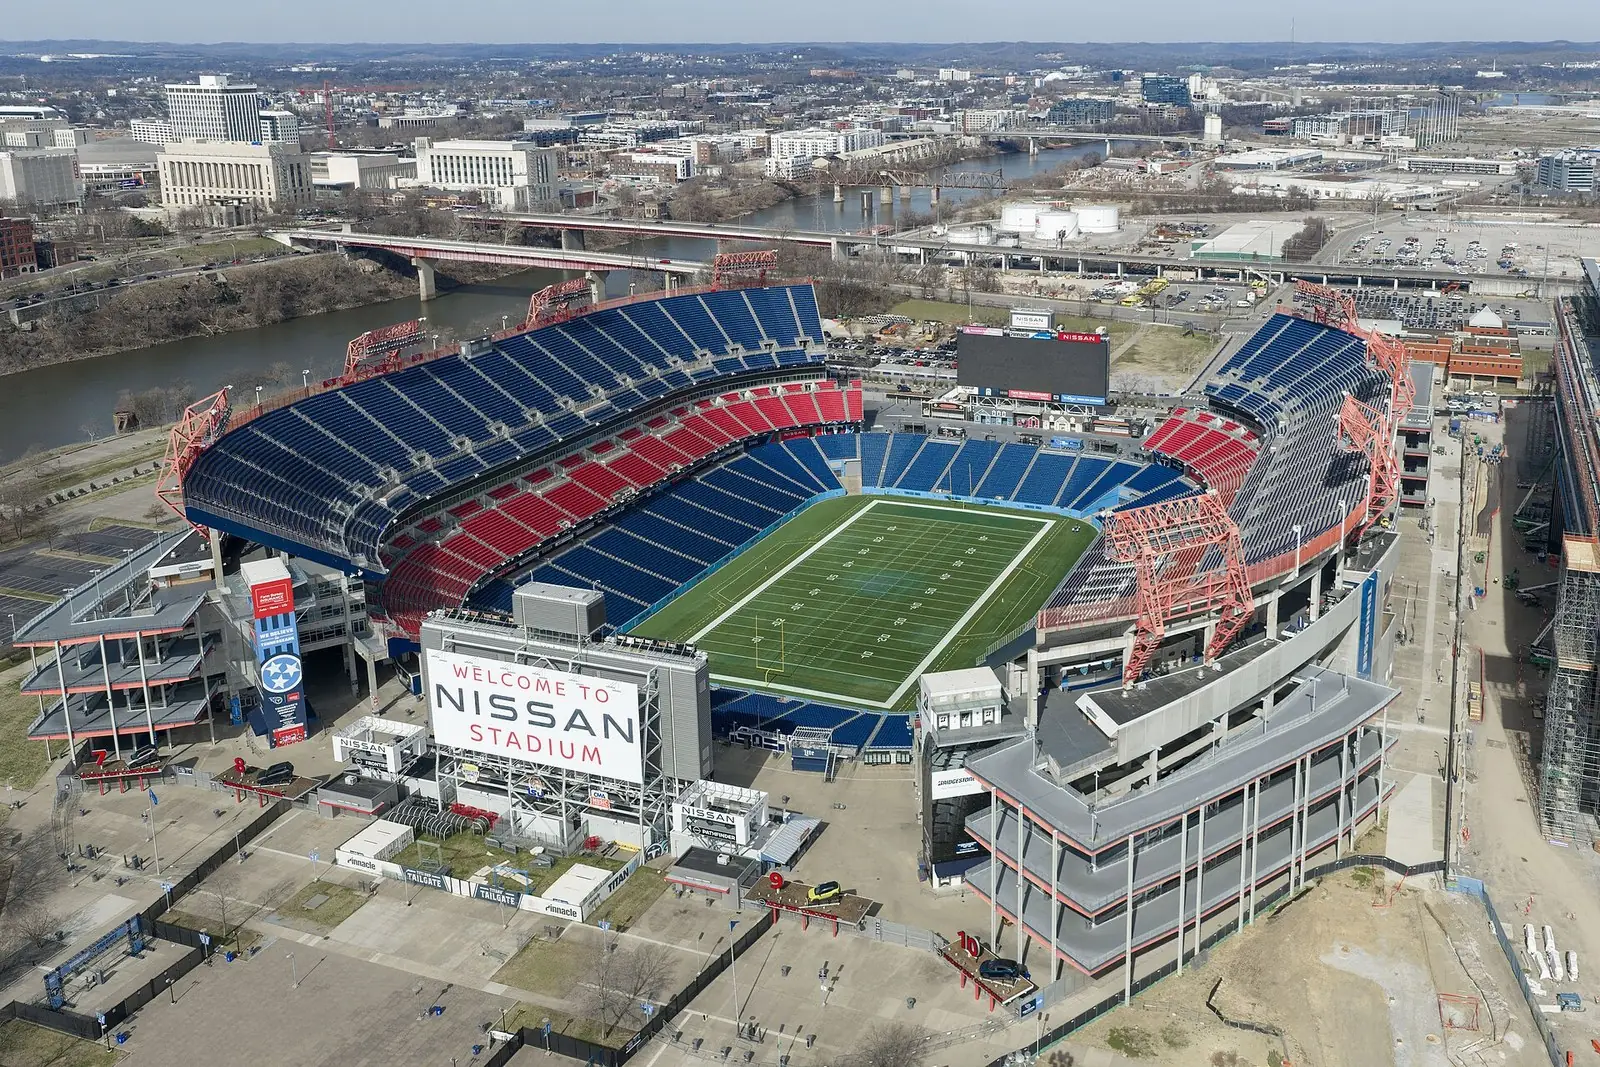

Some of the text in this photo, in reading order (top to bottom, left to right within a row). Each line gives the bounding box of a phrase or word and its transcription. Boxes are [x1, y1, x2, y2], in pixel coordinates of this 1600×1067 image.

[1063, 334, 1096, 342] NISSAN
[260, 627, 294, 640] WE BELIEVE
[453, 663, 609, 703] WELCOME TO
[436, 683, 634, 744] NISSAN
[340, 738, 386, 754] NISSAN
[470, 723, 603, 766] STADIUM
[91, 749, 108, 766] 7
[234, 757, 246, 773] 8
[681, 806, 736, 824] NISSAN
[702, 829, 736, 841] PATHFINDER
[407, 872, 442, 888] TAILGATE
[608, 867, 629, 893] TITAN
[769, 872, 784, 889] 9
[480, 890, 516, 906] TAILGATE
[957, 930, 980, 957] 10
